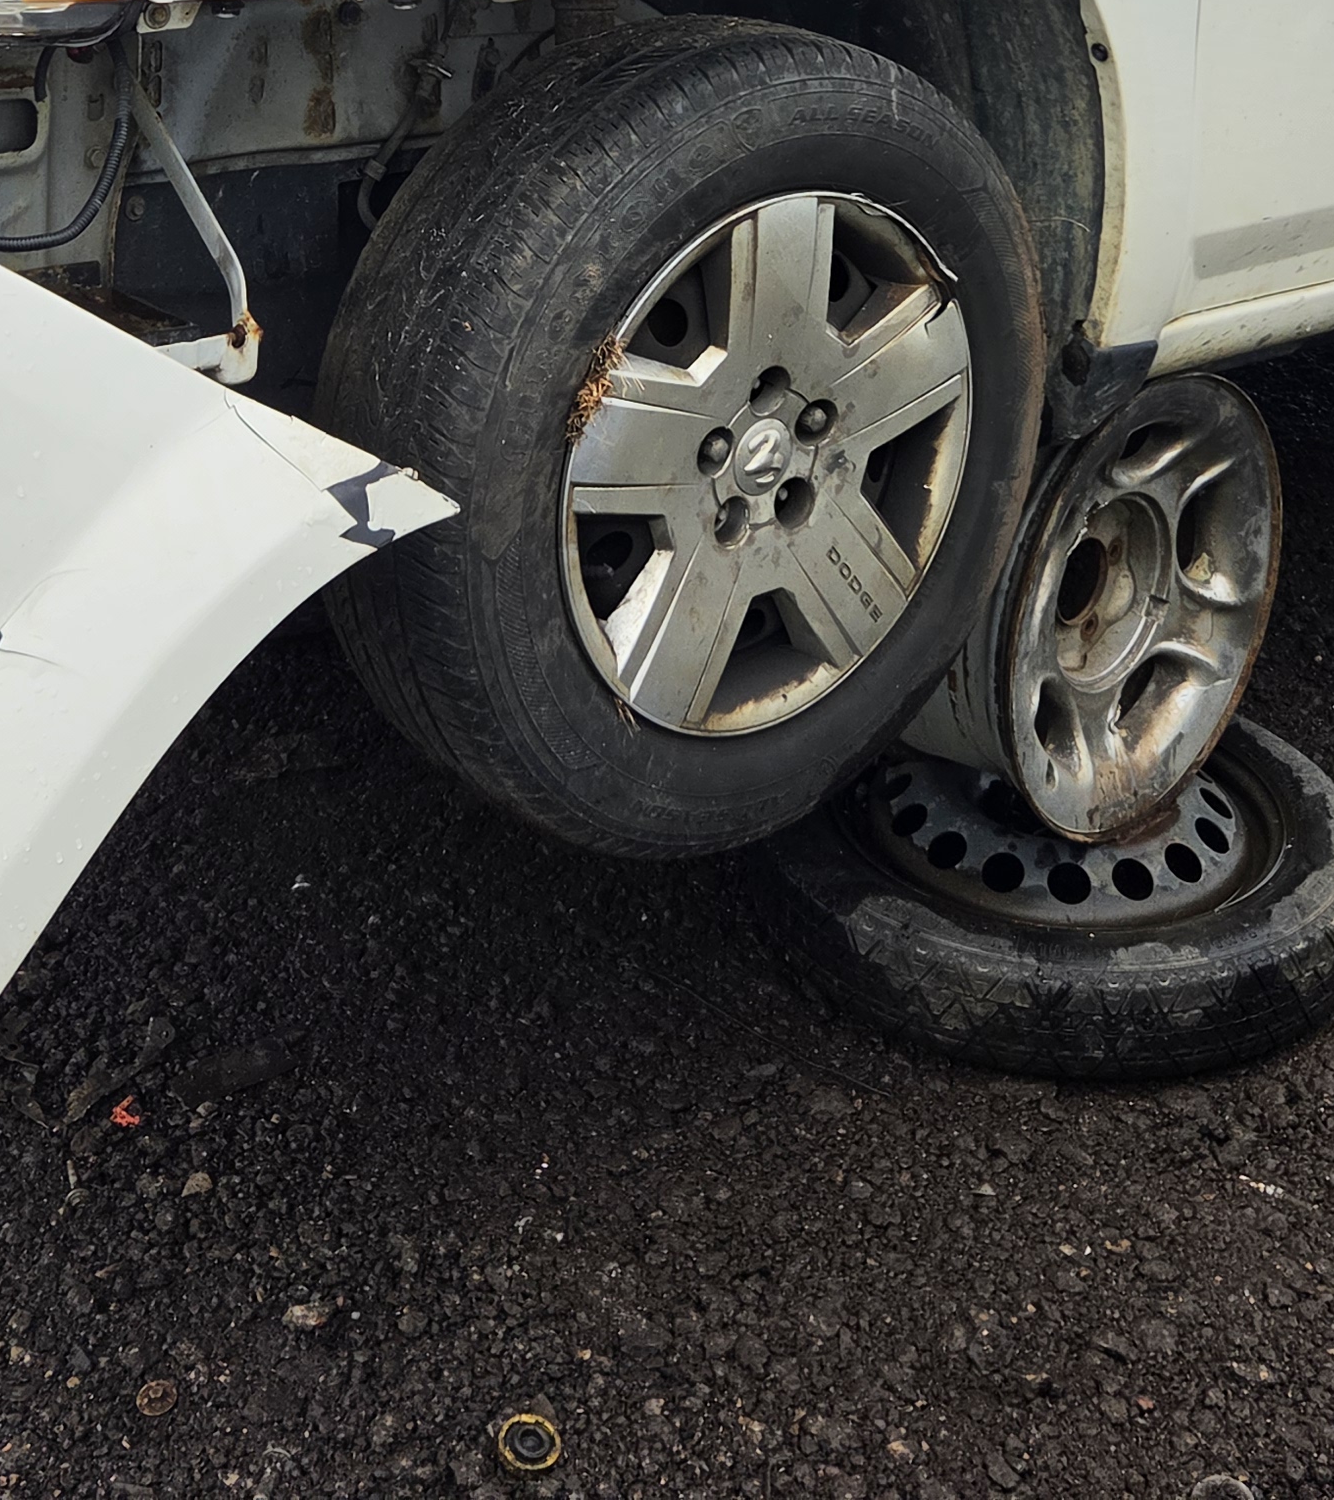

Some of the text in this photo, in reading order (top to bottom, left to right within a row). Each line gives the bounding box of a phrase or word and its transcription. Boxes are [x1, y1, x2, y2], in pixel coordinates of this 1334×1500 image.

[788, 104, 939, 150] ALL SEASON
[826, 545, 883, 623] DODGE
